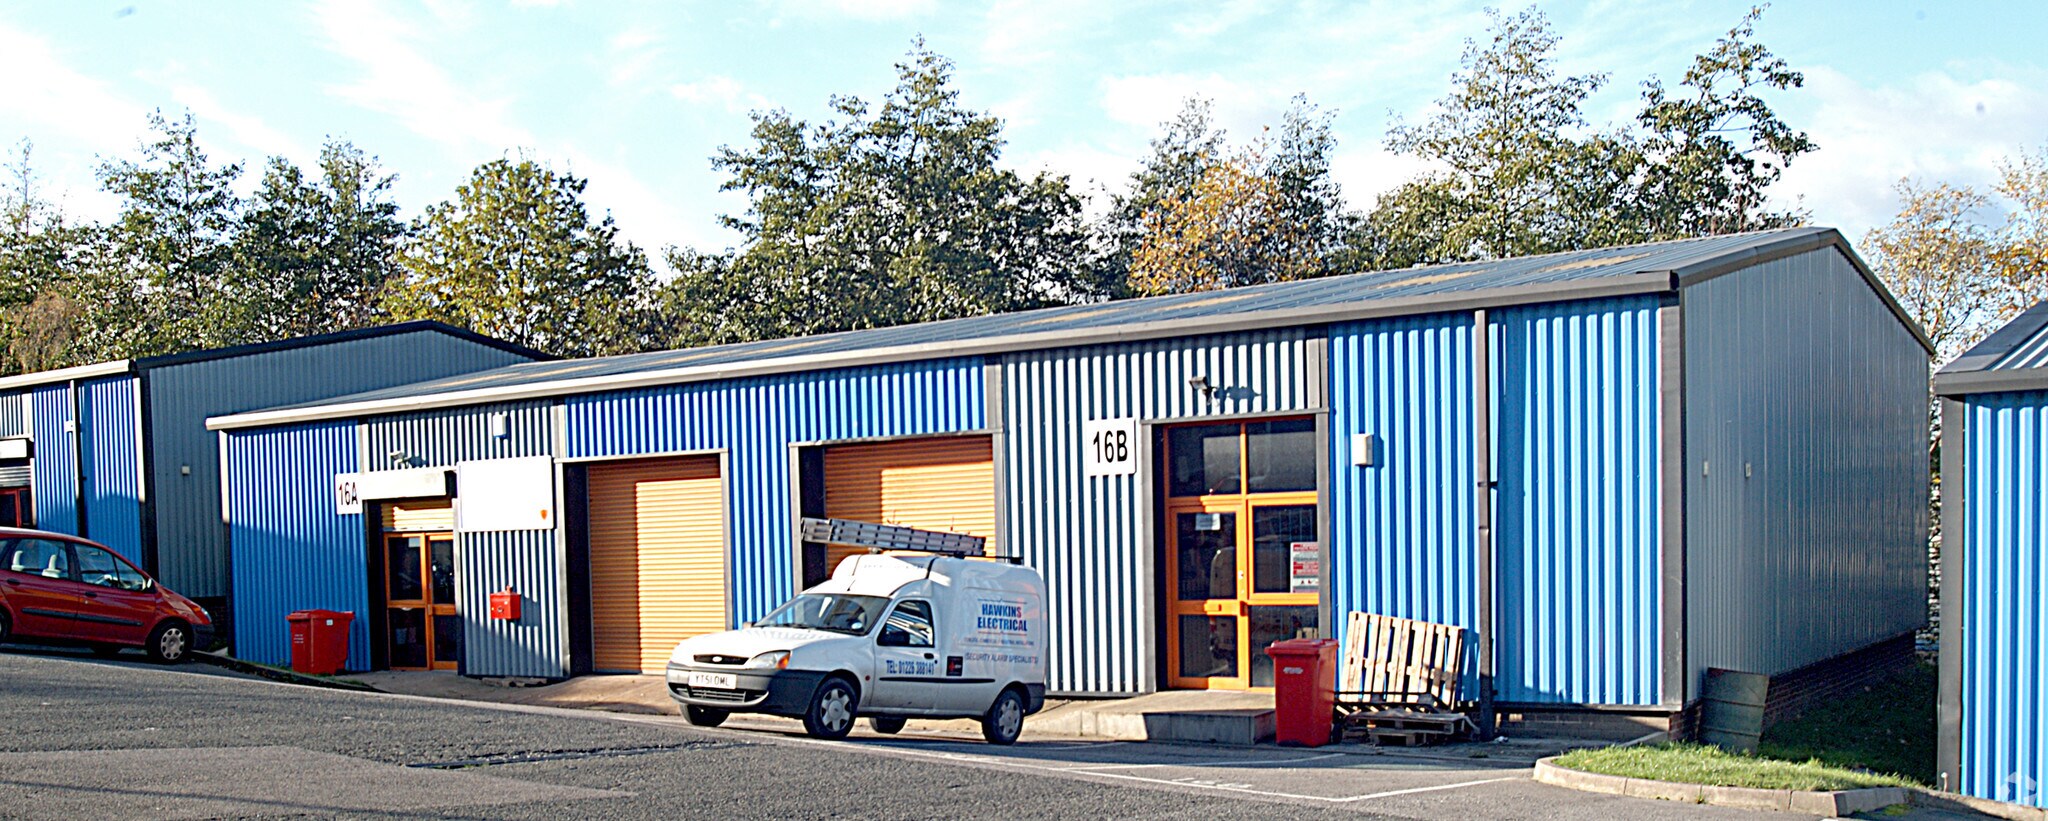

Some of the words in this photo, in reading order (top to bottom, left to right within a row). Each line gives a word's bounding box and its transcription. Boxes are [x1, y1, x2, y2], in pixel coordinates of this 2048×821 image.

[1093, 430, 1128, 463] 16B
[338, 482, 359, 505] 16A
[982, 604, 1022, 618] HAWKINS
[978, 617, 1028, 632] ELECTRICAL
